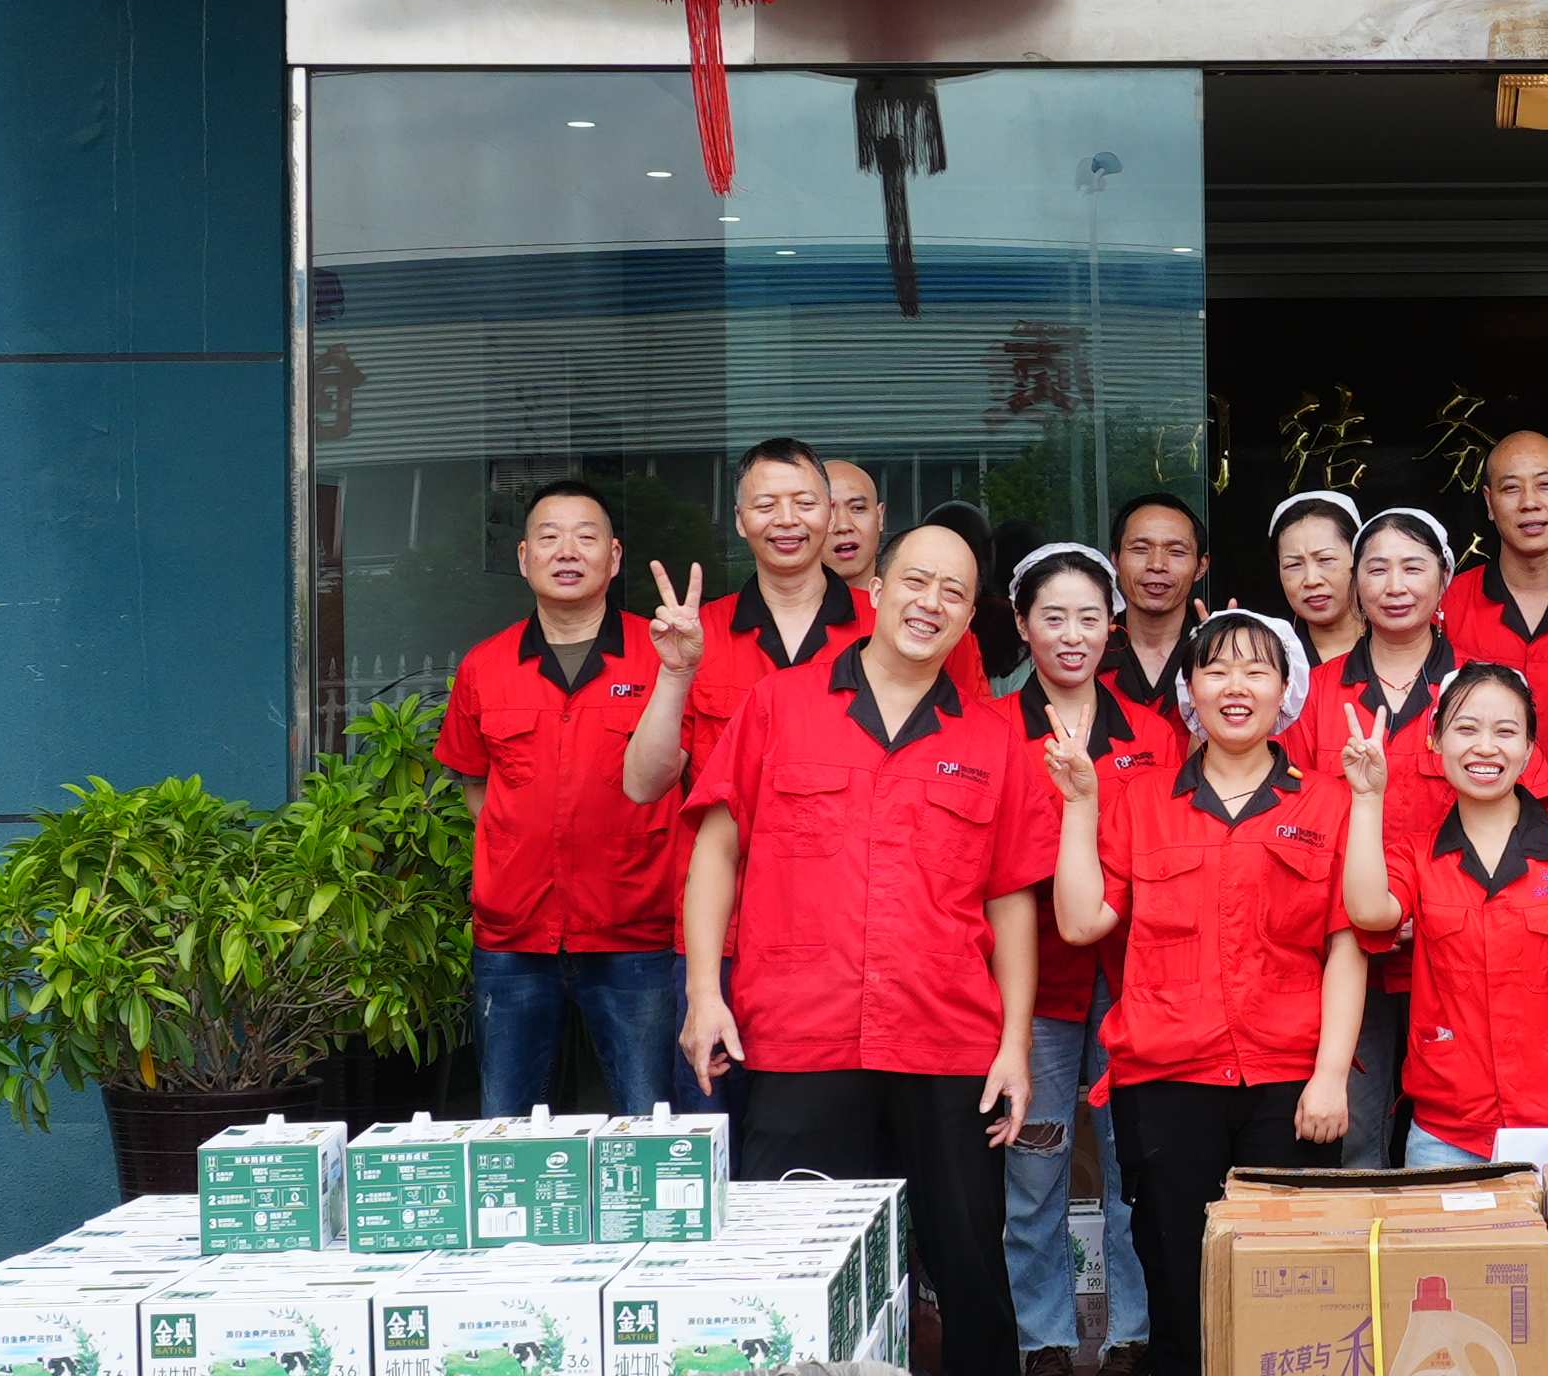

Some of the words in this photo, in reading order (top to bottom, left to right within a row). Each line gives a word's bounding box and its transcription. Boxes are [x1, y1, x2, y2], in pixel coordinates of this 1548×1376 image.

[155, 1318, 194, 1346] 金典
[388, 1311, 426, 1339] 金典
[618, 1305, 657, 1333] 金典
